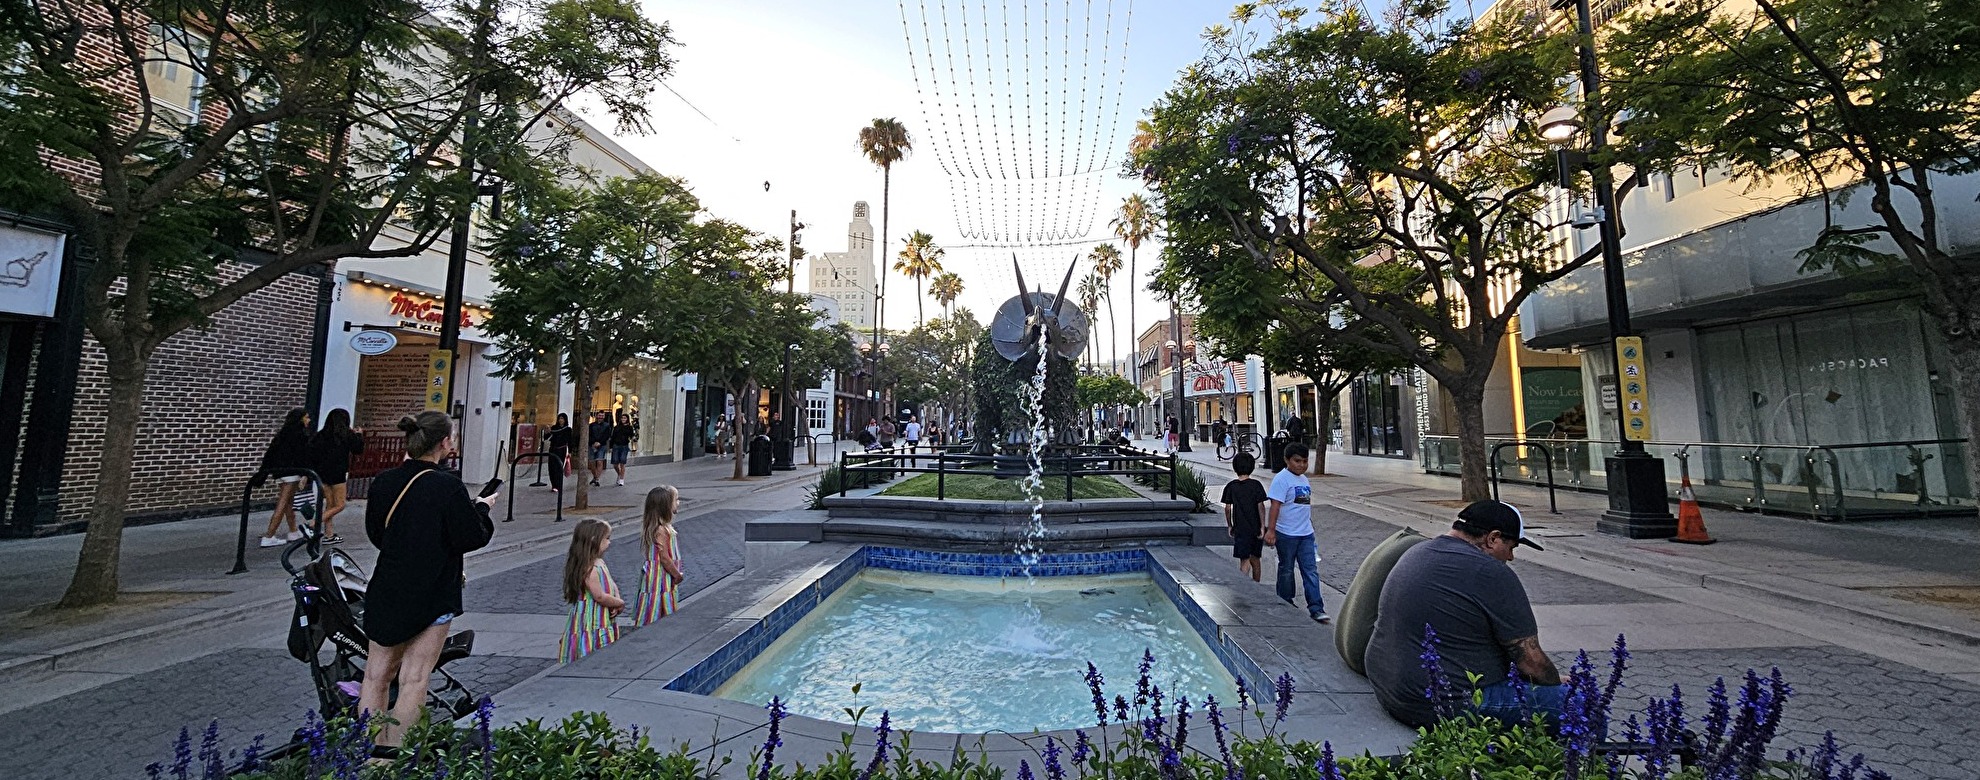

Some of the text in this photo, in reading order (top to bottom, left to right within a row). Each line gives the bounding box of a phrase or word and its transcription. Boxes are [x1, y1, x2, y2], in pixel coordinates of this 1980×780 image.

[391, 291, 473, 328] McConl's
[1414, 363, 1426, 449] PROMENADE GATEW
[1528, 385, 1583, 397] Now Leas
